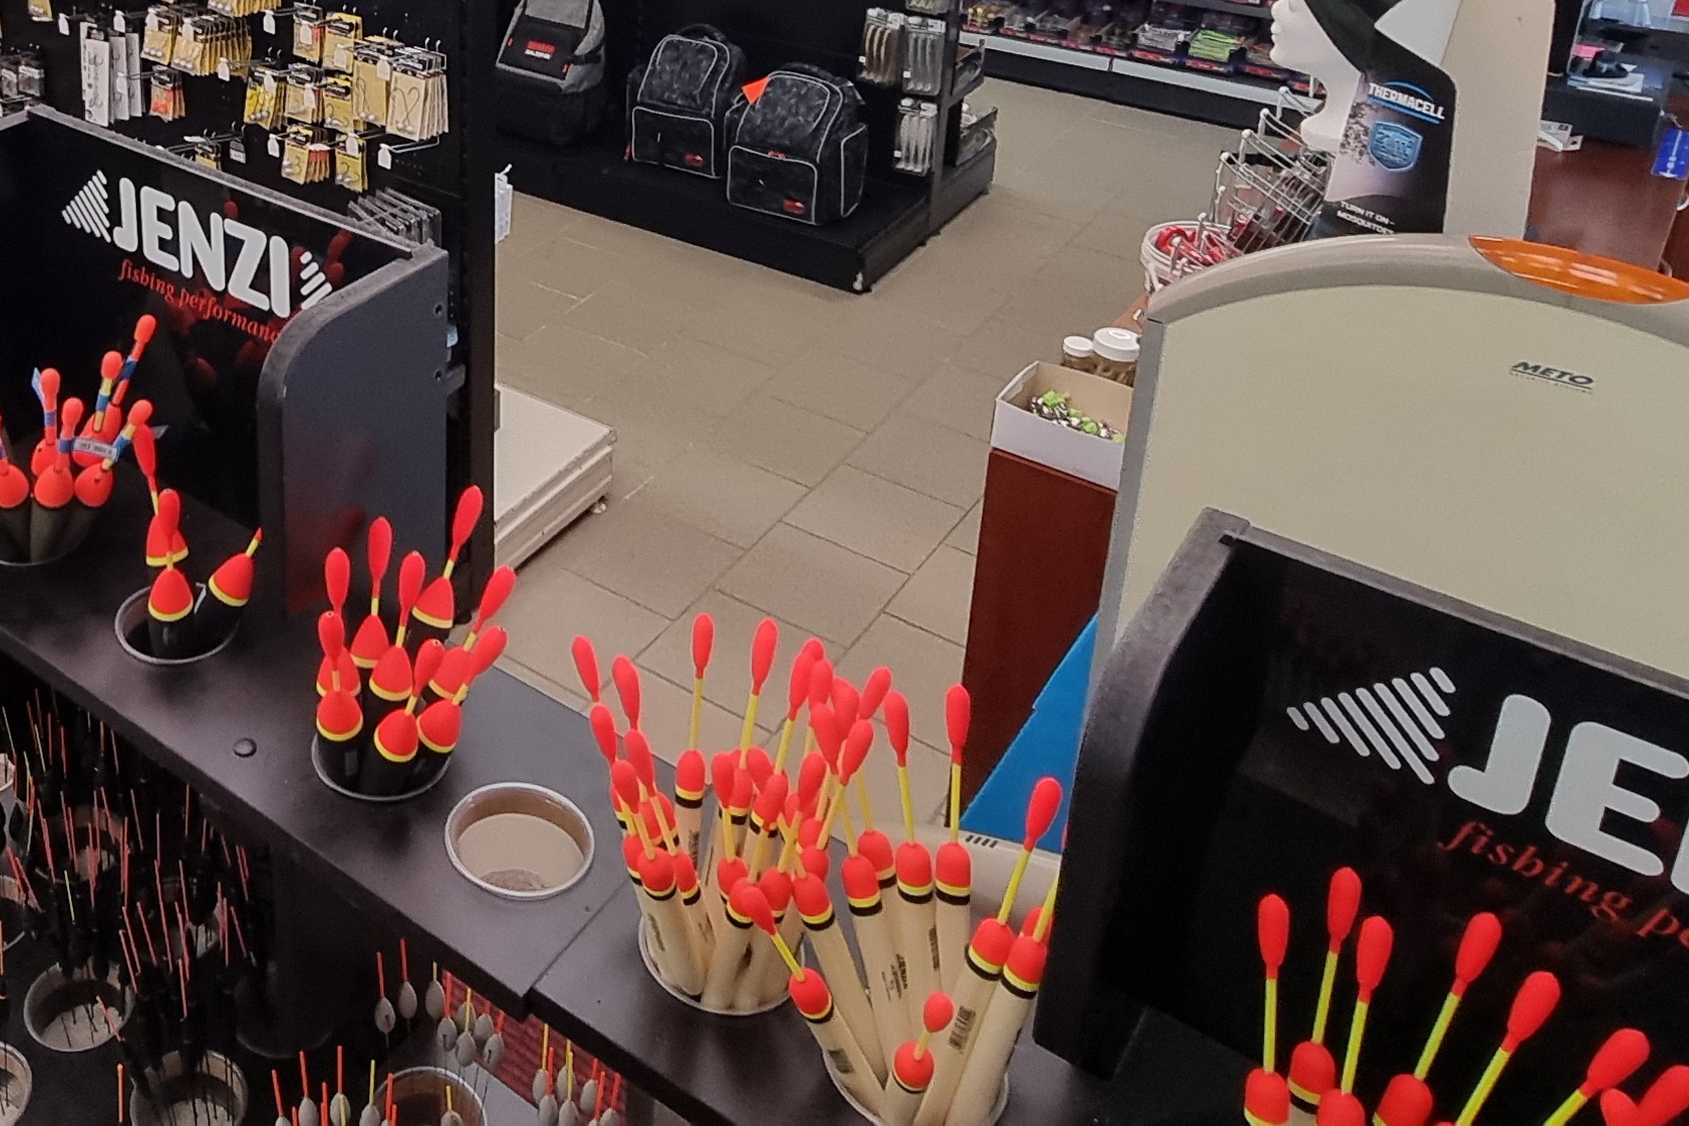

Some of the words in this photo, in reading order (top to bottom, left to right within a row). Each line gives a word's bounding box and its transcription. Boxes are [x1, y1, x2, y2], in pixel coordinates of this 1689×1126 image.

[1368, 82, 1446, 120] THERMACELL
[113, 177, 291, 318] JENZI
[118, 259, 175, 302] fishing
[1512, 362, 1594, 385] METO
[1438, 820, 1634, 922] fishing
